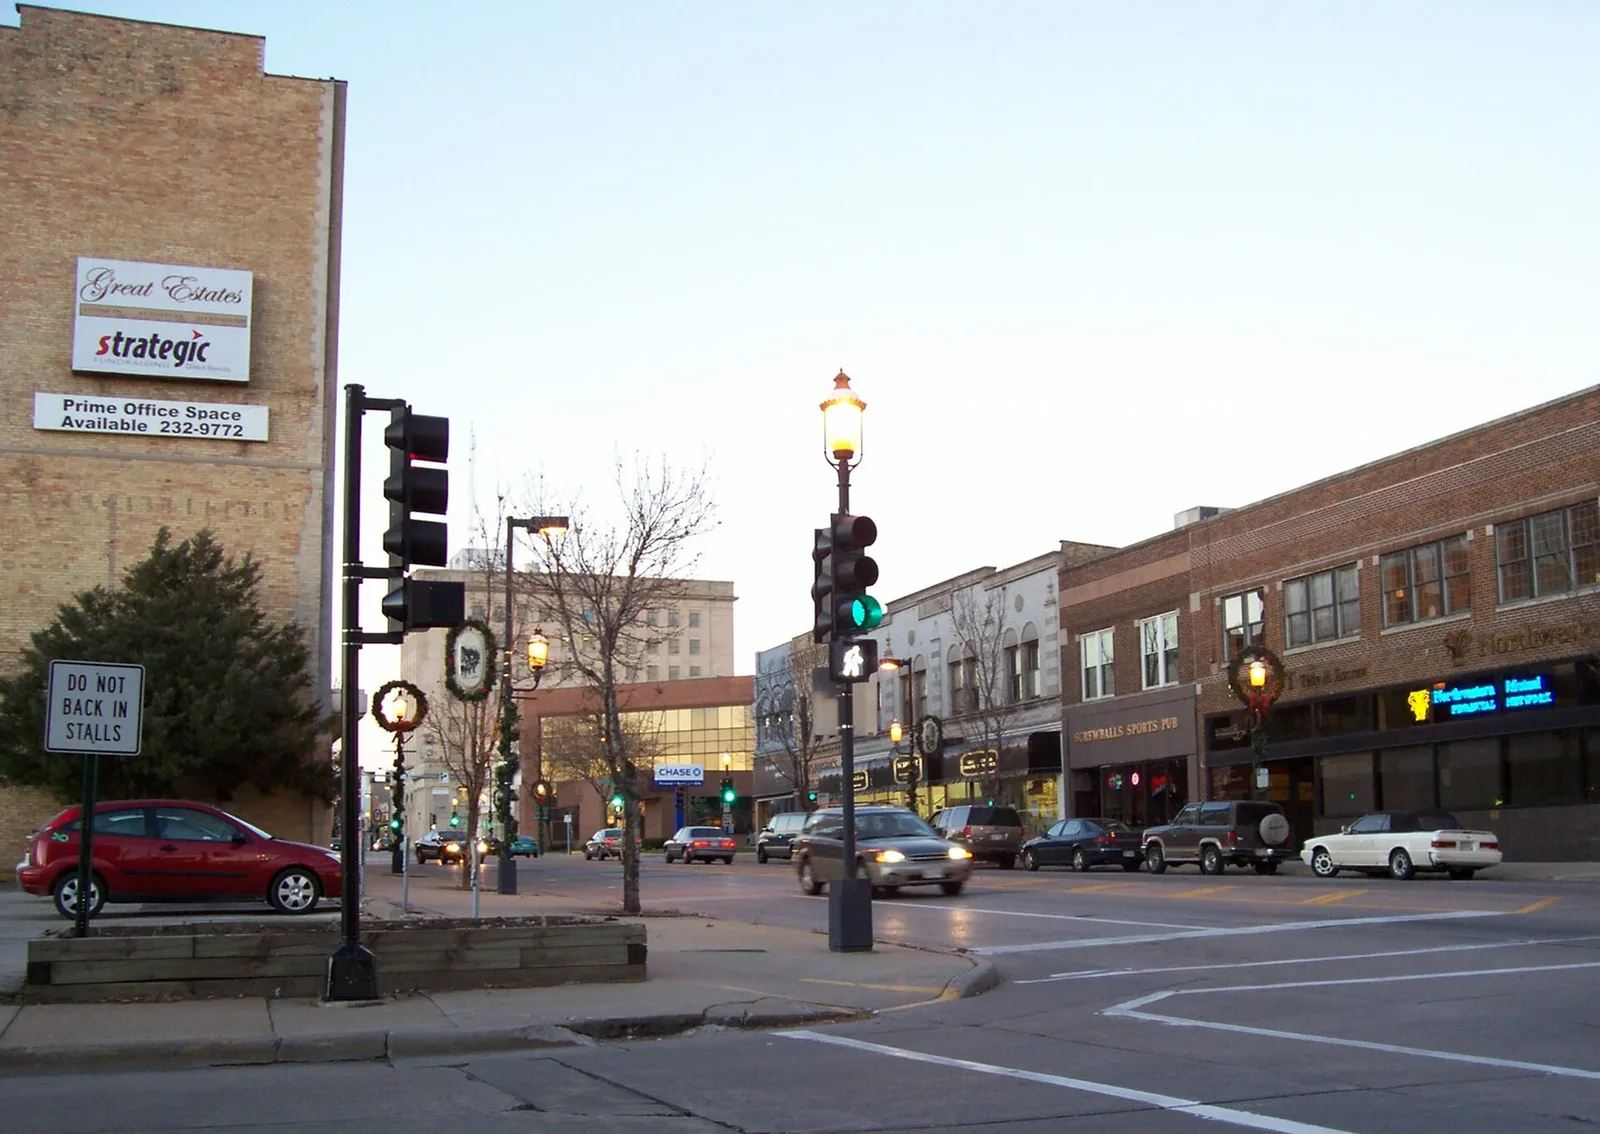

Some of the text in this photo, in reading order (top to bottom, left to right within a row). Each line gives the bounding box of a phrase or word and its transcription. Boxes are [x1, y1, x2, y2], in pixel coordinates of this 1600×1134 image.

[79, 267, 243, 303] Great Estates
[95, 330, 211, 368] strategic
[93, 358, 170, 369] FUNDRAISING
[63, 398, 242, 423] Prime Office Space
[61, 415, 243, 437] Available 232-9772
[68, 674, 126, 694] DO NOT
[63, 698, 128, 718] BACK IN
[66, 722, 122, 742] STALLS
[1074, 717, 1179, 744] SCREWBALLS SPORTS PUB
[659, 768, 691, 776] CHASE
